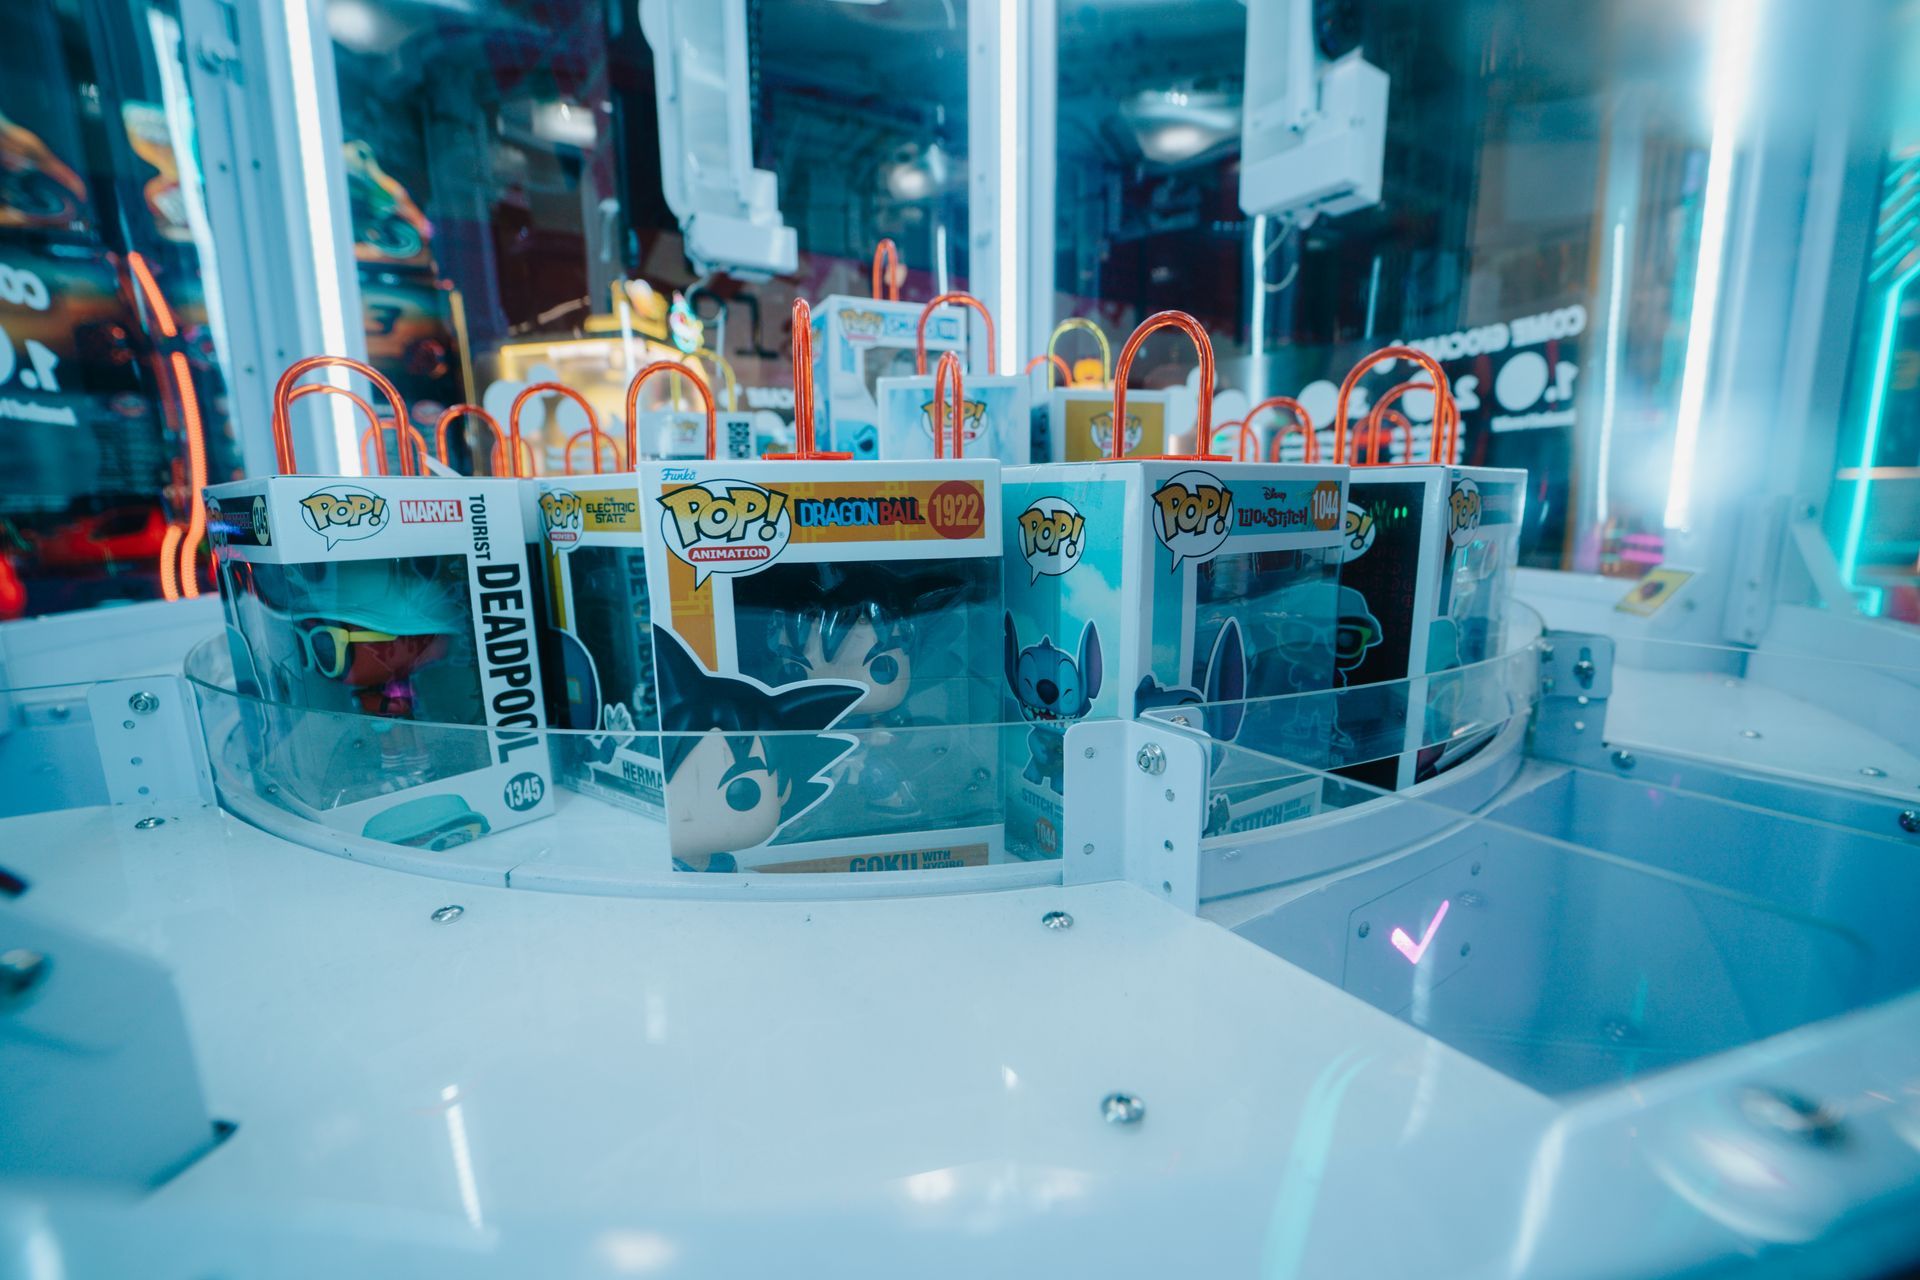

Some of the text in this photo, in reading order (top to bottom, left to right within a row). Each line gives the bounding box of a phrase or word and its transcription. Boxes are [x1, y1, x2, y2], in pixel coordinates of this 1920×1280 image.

[300, 493, 387, 531] POP!
[402, 500, 462, 522] MARVEL
[538, 492, 582, 533] POP!
[585, 502, 636, 514] ELECTRIC
[595, 512, 626, 524] STATE
[655, 484, 789, 549] POP!
[931, 493, 980, 527] 1922
[1151, 482, 1234, 543] POP!
[1312, 489, 1339, 520] 1044
[1447, 488, 1481, 535] POP!
[469, 494, 491, 561] TOURIST
[1018, 507, 1086, 559] POP!
[691, 548, 769, 561] ANIMATION
[476, 563, 540, 764] DEADPOOL
[505, 776, 541, 805] 1345
[1230, 804, 1285, 834] STITCH
[922, 849, 951, 862] WITH
